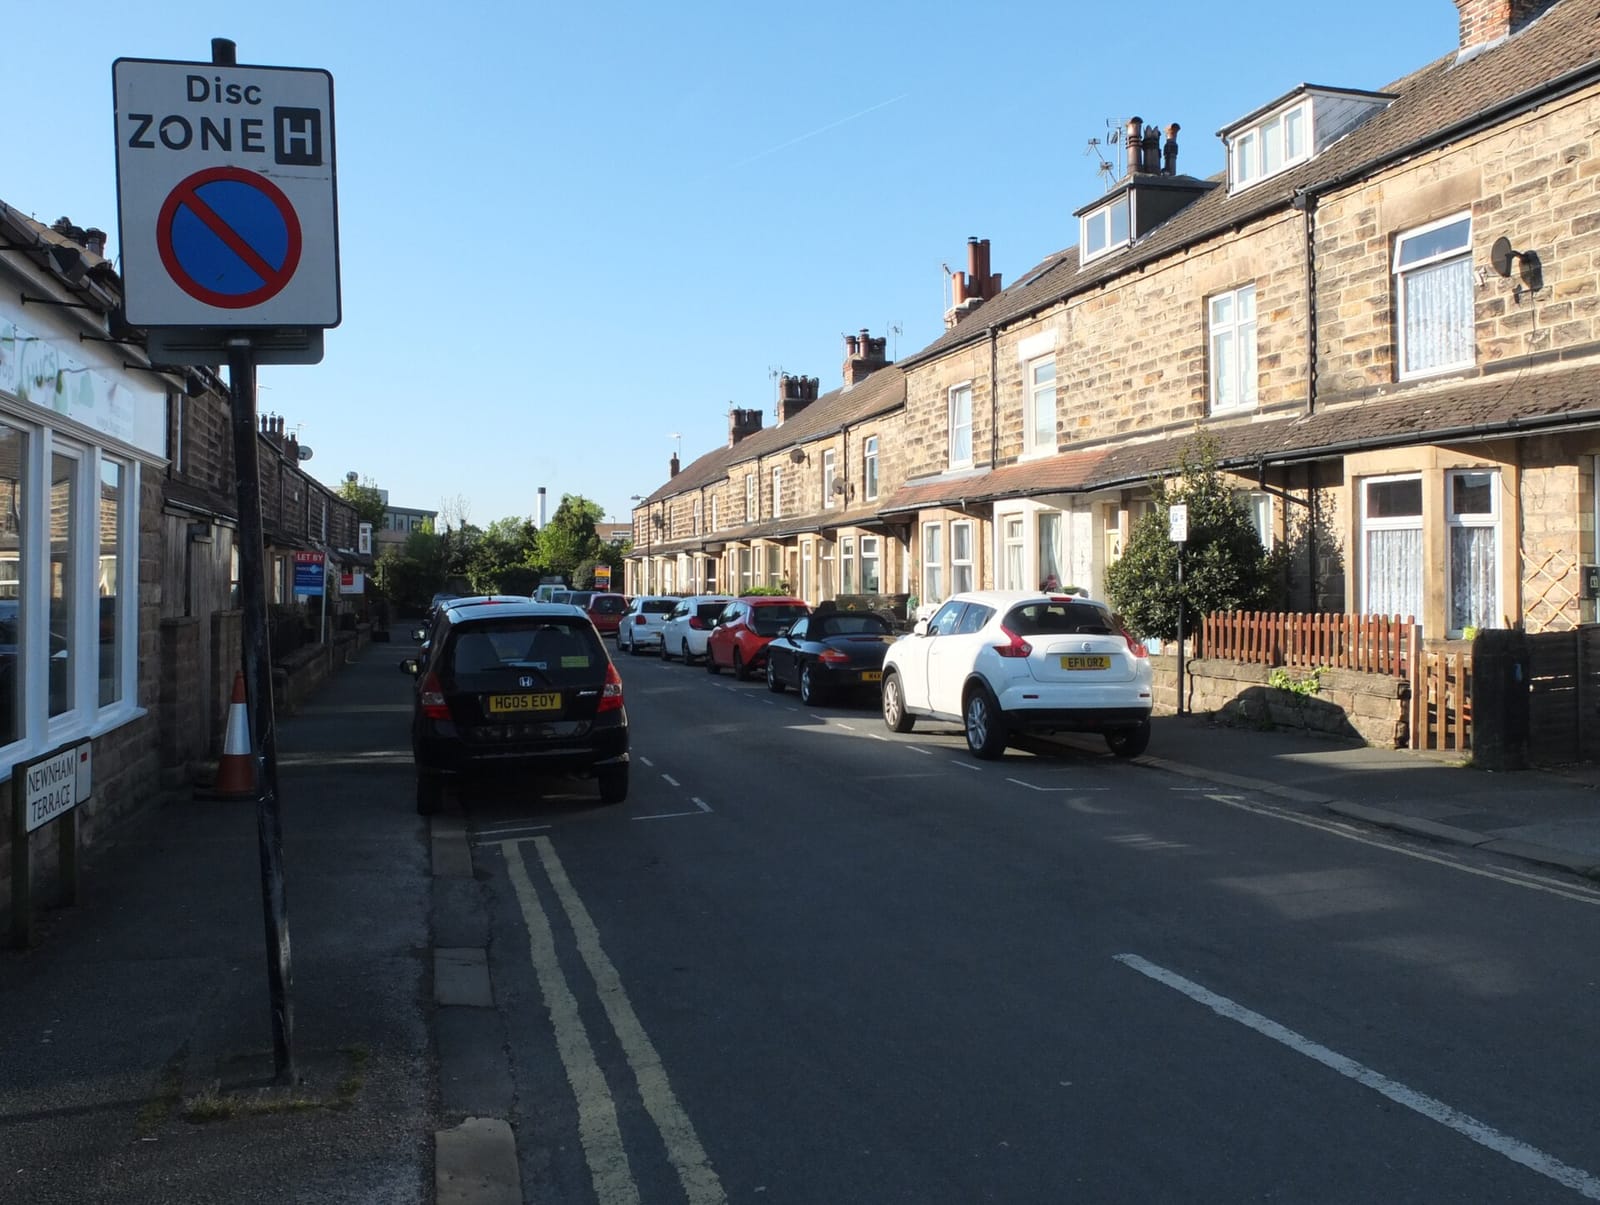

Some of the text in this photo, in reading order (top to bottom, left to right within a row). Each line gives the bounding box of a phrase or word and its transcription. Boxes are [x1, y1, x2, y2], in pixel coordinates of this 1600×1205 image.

[186, 75, 262, 105] Disc
[128, 113, 312, 155] ZONE H
[297, 553, 323, 561] LET BY
[495, 696, 528, 709] HG05
[28, 754, 74, 797] NEWNHAM
[32, 784, 71, 822] TERRACE
